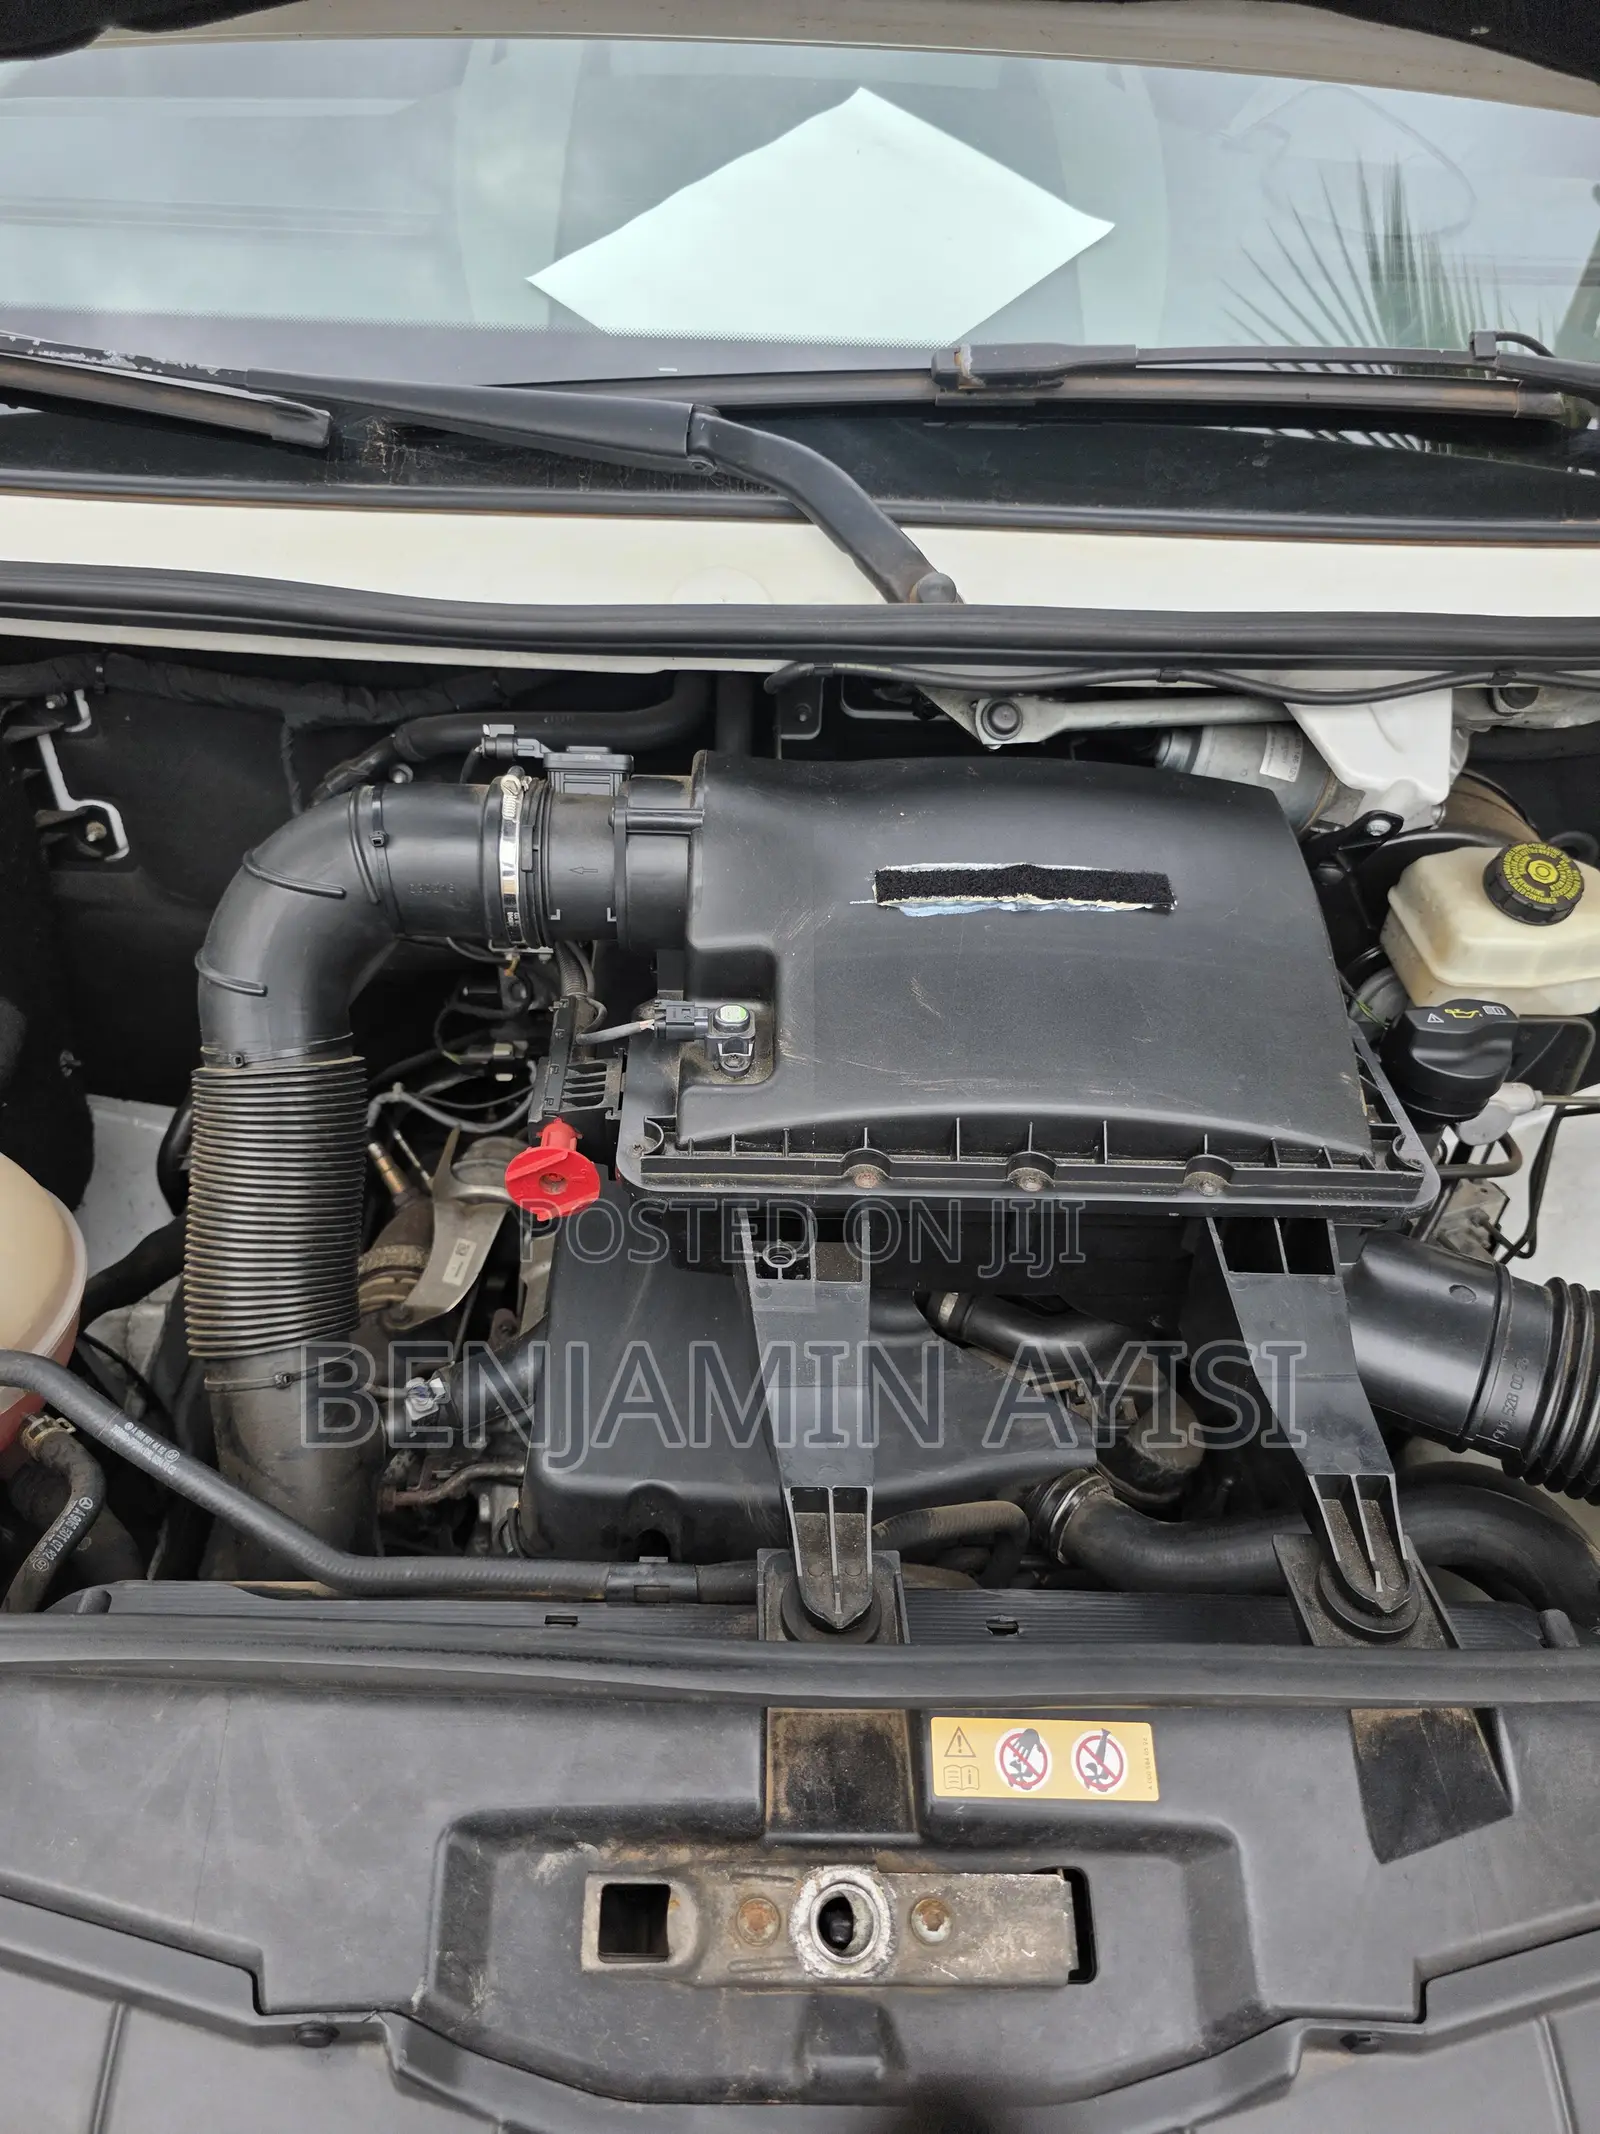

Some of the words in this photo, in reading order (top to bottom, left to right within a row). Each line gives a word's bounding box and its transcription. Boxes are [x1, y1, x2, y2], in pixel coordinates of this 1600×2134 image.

[73, 1507, 86, 1517] A
[65, 1514, 81, 1530] 906
[56, 1526, 73, 1542] 501
[49, 1539, 63, 1552] 07
[42, 1548, 57, 1560] 82
